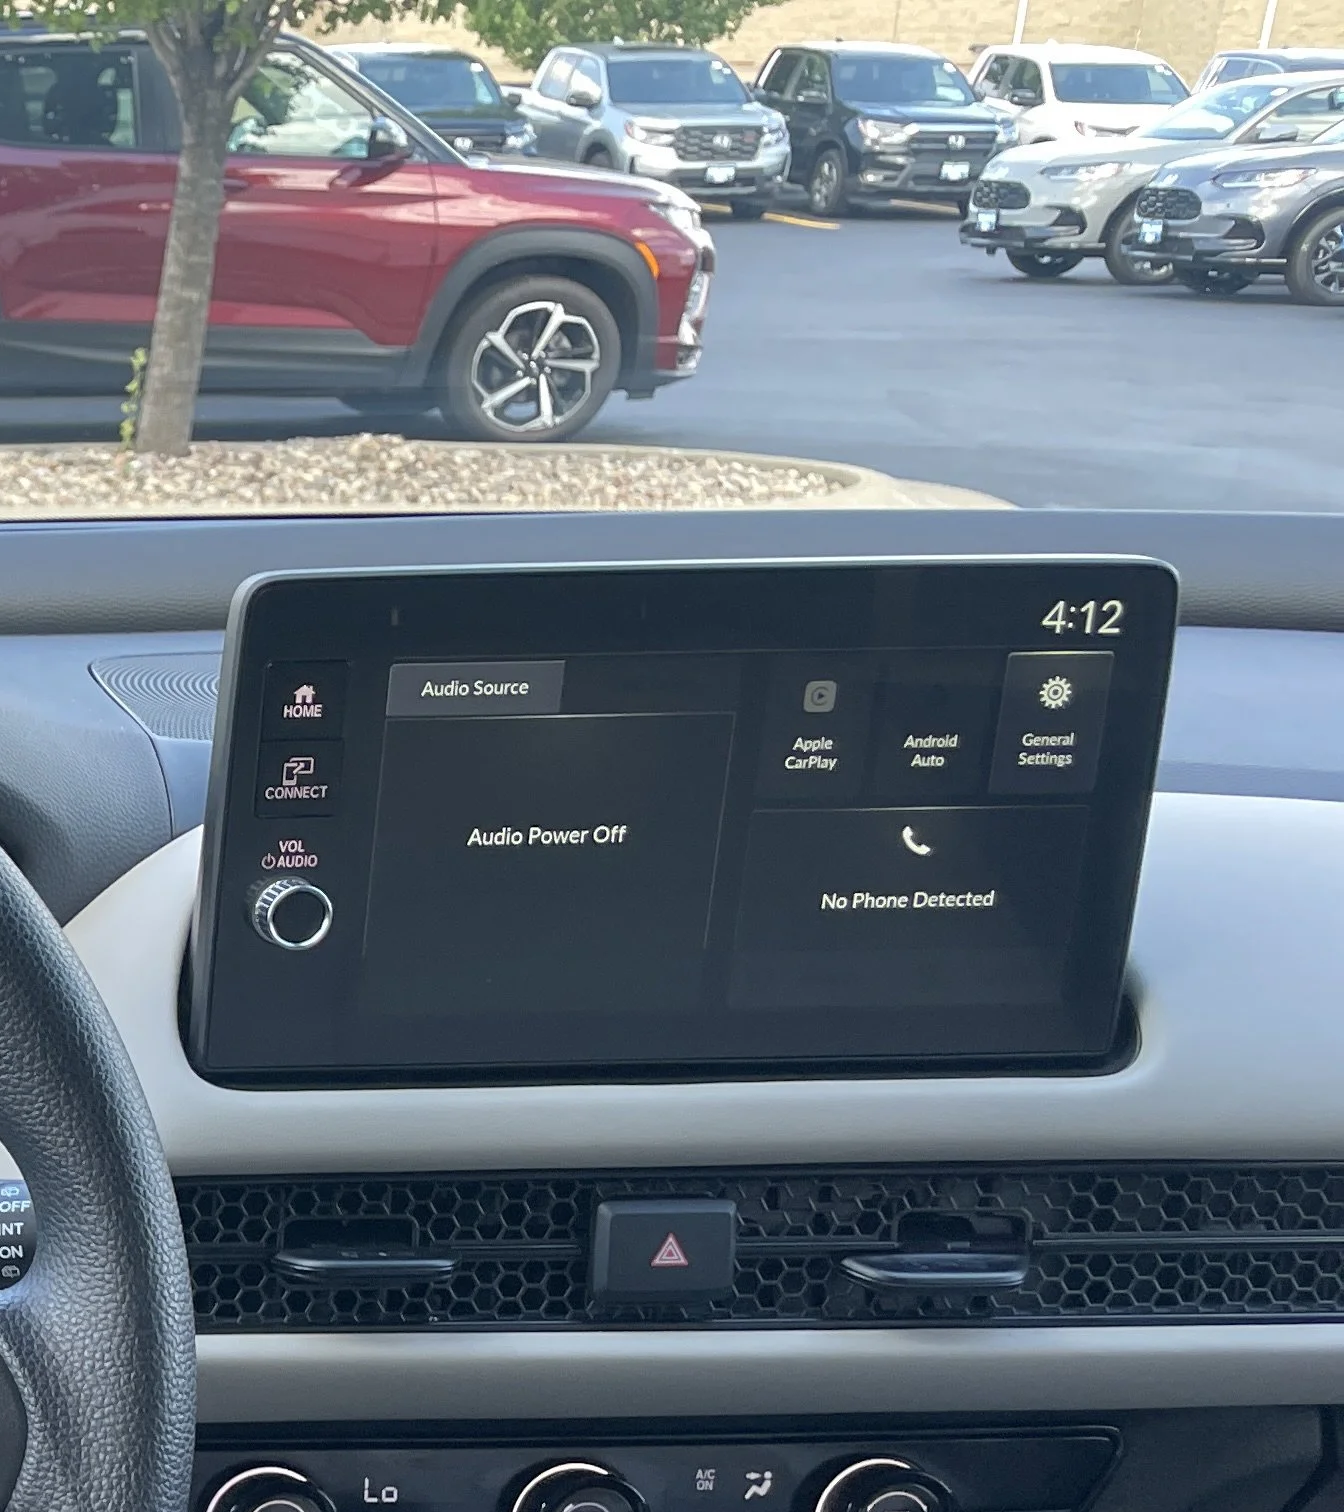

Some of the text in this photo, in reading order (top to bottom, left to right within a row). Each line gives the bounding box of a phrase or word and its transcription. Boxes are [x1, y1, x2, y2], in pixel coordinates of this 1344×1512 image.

[1040, 600, 1125, 635] 4:12
[421, 679, 529, 697] Audio Source
[283, 704, 322, 718] HOME
[793, 737, 834, 752] Apple
[904, 734, 959, 749] Android
[1022, 732, 1074, 747] General
[784, 755, 837, 771] CarPlay
[911, 753, 945, 767] Auto
[1018, 752, 1073, 767] Settings
[265, 785, 328, 800] CONNECT
[467, 825, 627, 846] Audio Power Off
[279, 840, 305, 854] VOL
[276, 854, 318, 868] AUDIO
[821, 889, 995, 909] No Phone Detected
[695, 1469, 716, 1480] A/C
[696, 1480, 714, 1491] ON
